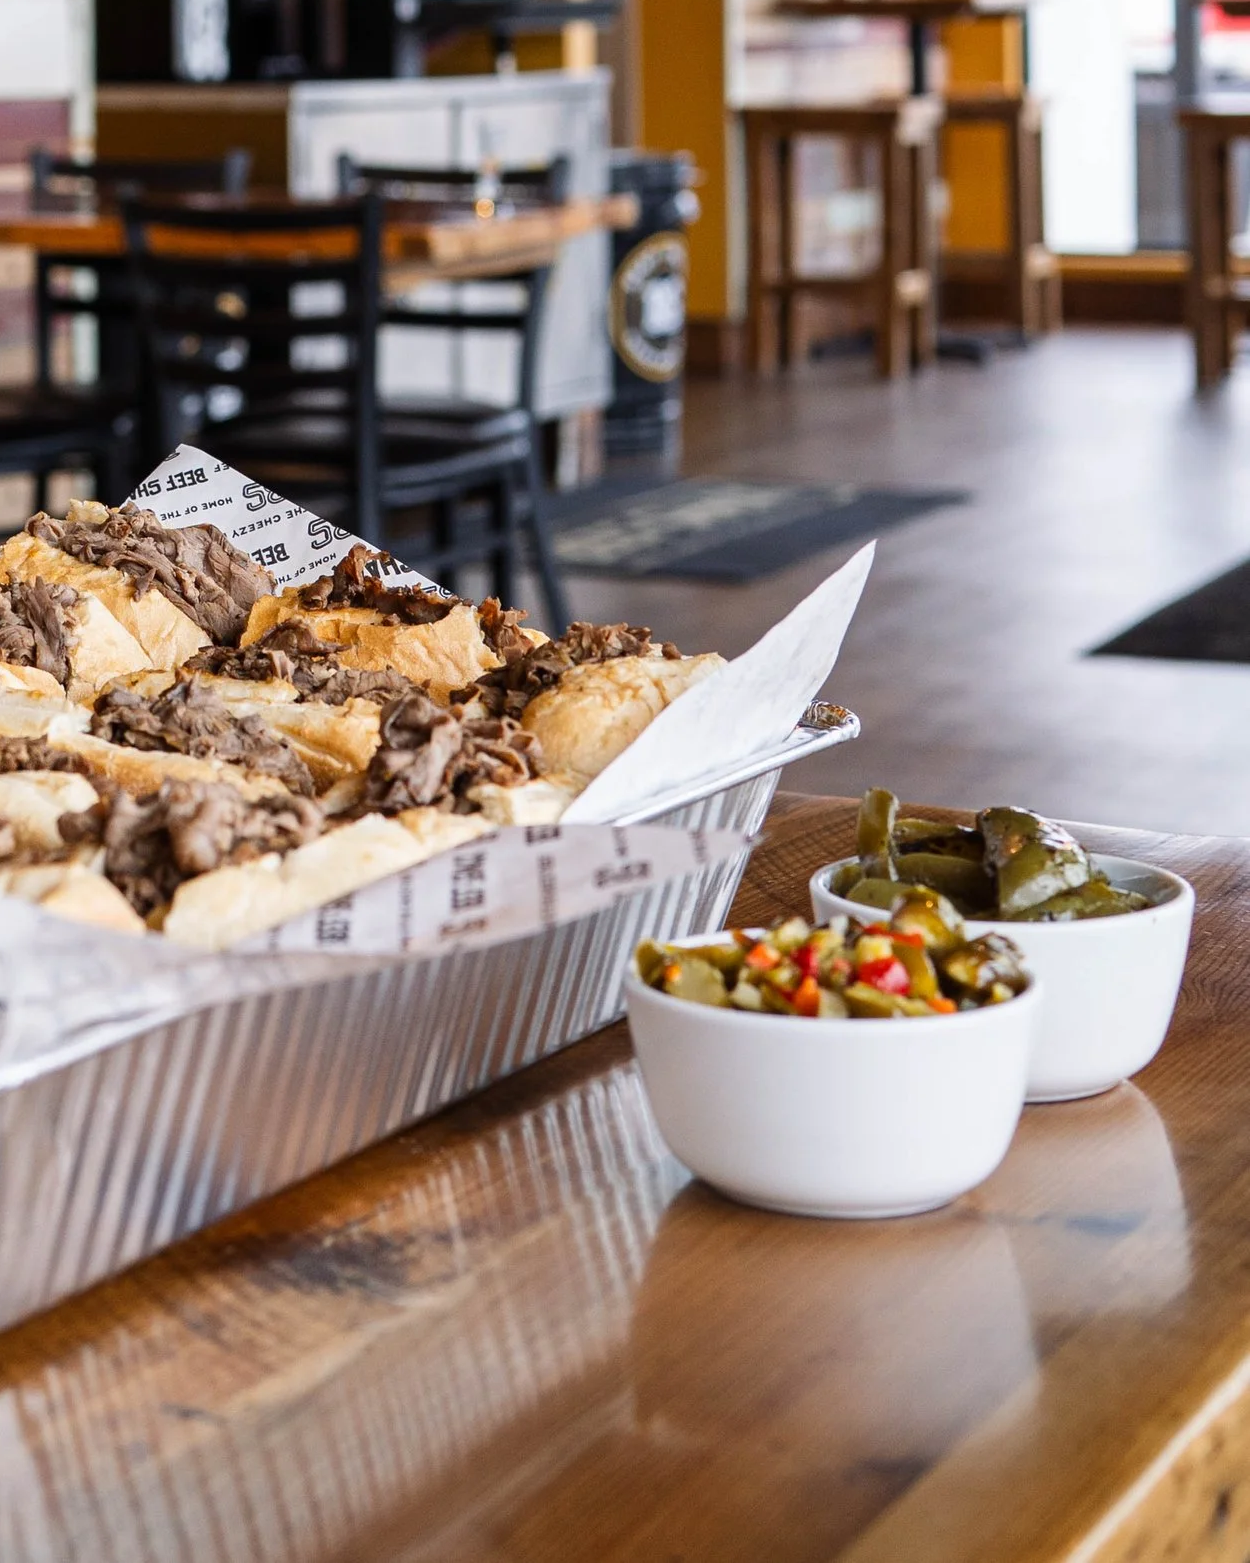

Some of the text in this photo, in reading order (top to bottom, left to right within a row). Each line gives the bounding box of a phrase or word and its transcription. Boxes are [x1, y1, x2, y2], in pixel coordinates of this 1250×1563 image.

[166, 467, 209, 492] BEEF
[160, 496, 233, 522] HOME OF THE
[231, 513, 282, 539] CHEEZY
[247, 542, 292, 568] BEE
[308, 552, 338, 571] HOME
[294, 565, 307, 580] OF
